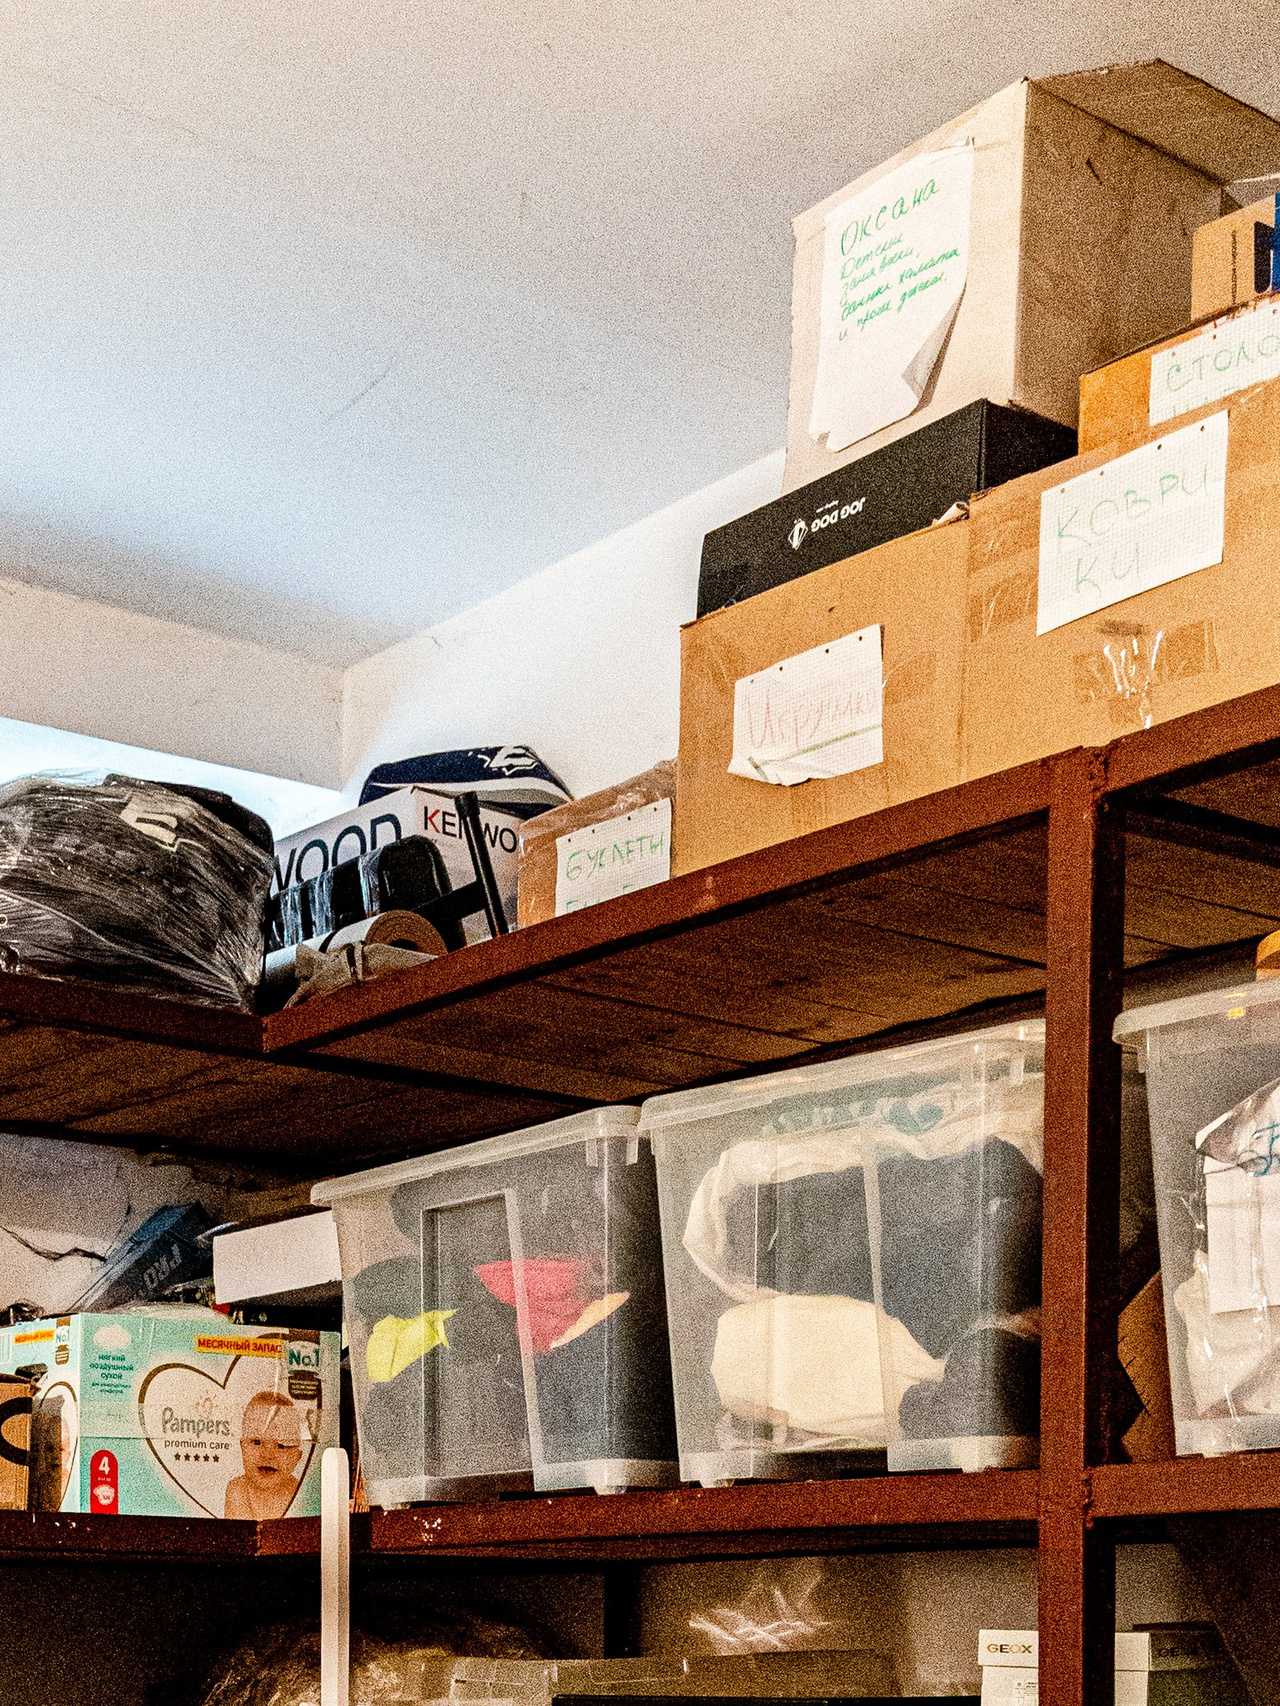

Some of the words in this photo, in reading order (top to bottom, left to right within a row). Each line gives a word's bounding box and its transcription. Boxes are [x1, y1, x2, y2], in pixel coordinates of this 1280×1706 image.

[840, 497, 866, 519] JOG
[811, 509, 839, 532] DOG
[198, 1338, 250, 1351] МЕСЯЧНЫЙ
[252, 1342, 282, 1354] ЗАПАС
[288, 1348, 320, 1367] No.1
[162, 1407, 230, 1438] Pampers
[164, 1440, 207, 1449] premium
[209, 1442, 230, 1450] care
[98, 1456, 110, 1475] 4
[986, 1644, 1033, 1654] GEOX
